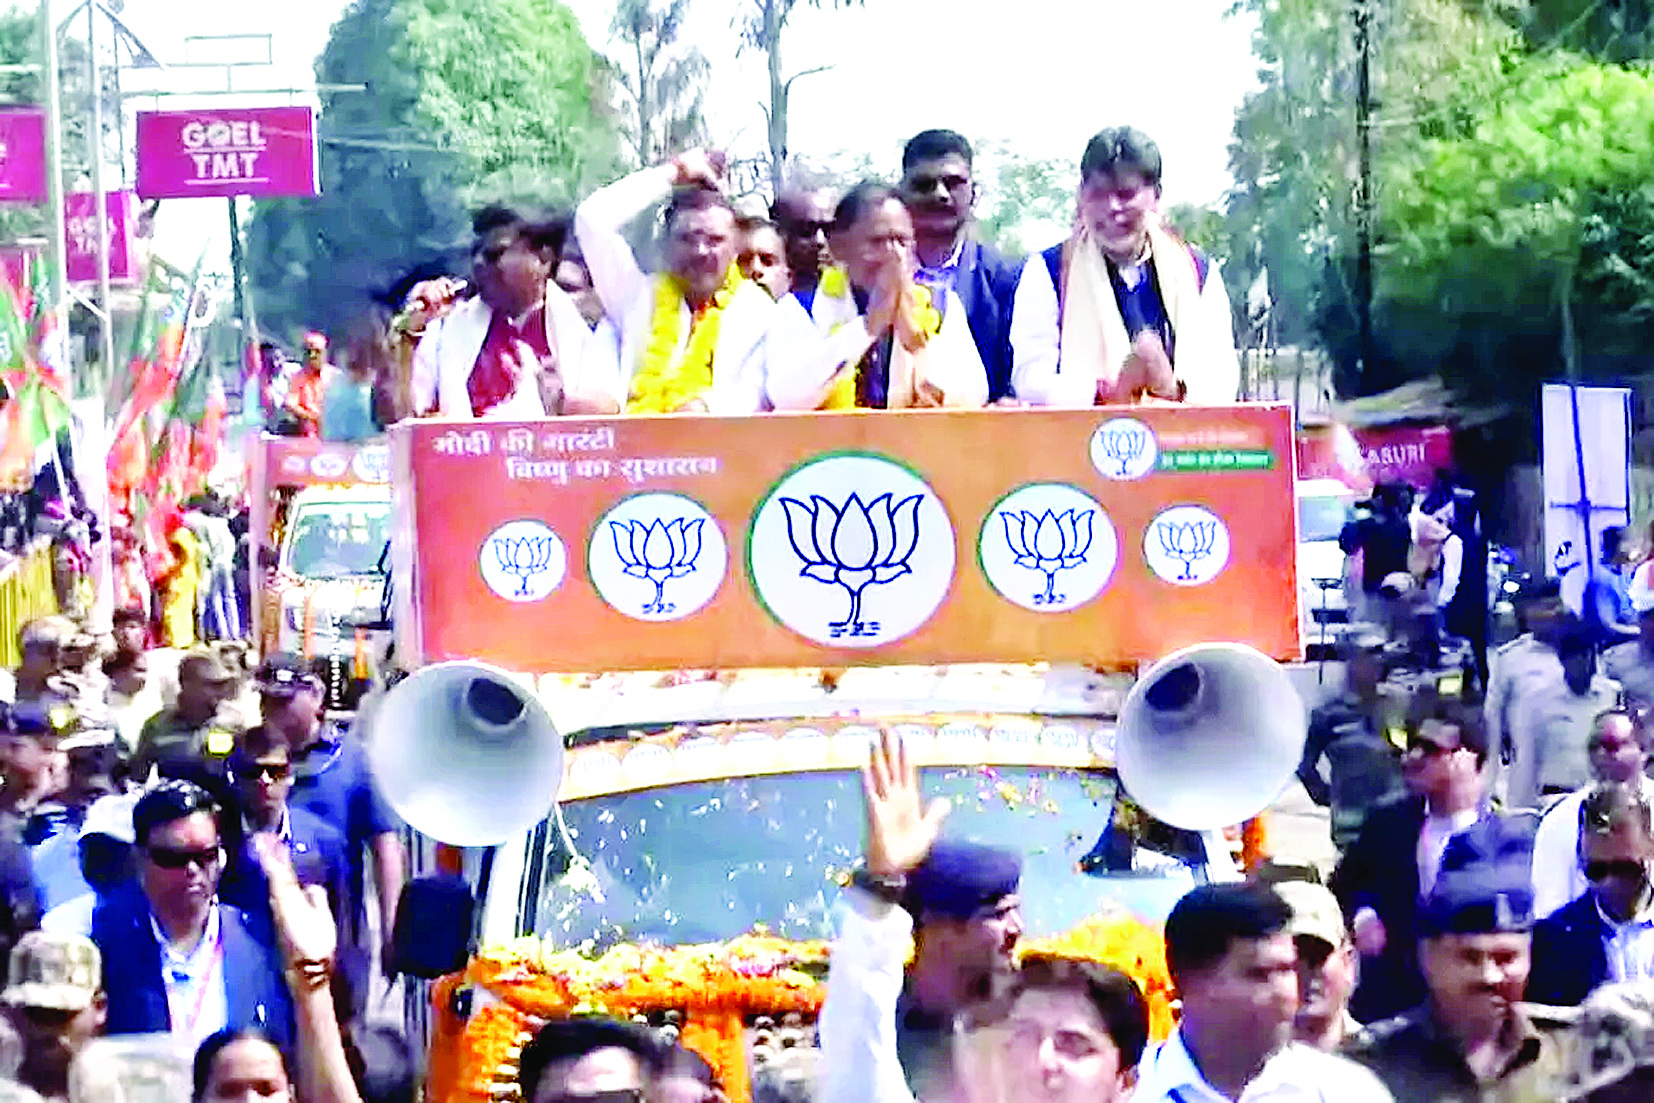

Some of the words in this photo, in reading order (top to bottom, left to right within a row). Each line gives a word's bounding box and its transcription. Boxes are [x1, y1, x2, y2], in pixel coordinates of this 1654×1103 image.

[181, 120, 267, 147] GOEL
[190, 152, 259, 179] TMT
[431, 430, 491, 454] मोदी
